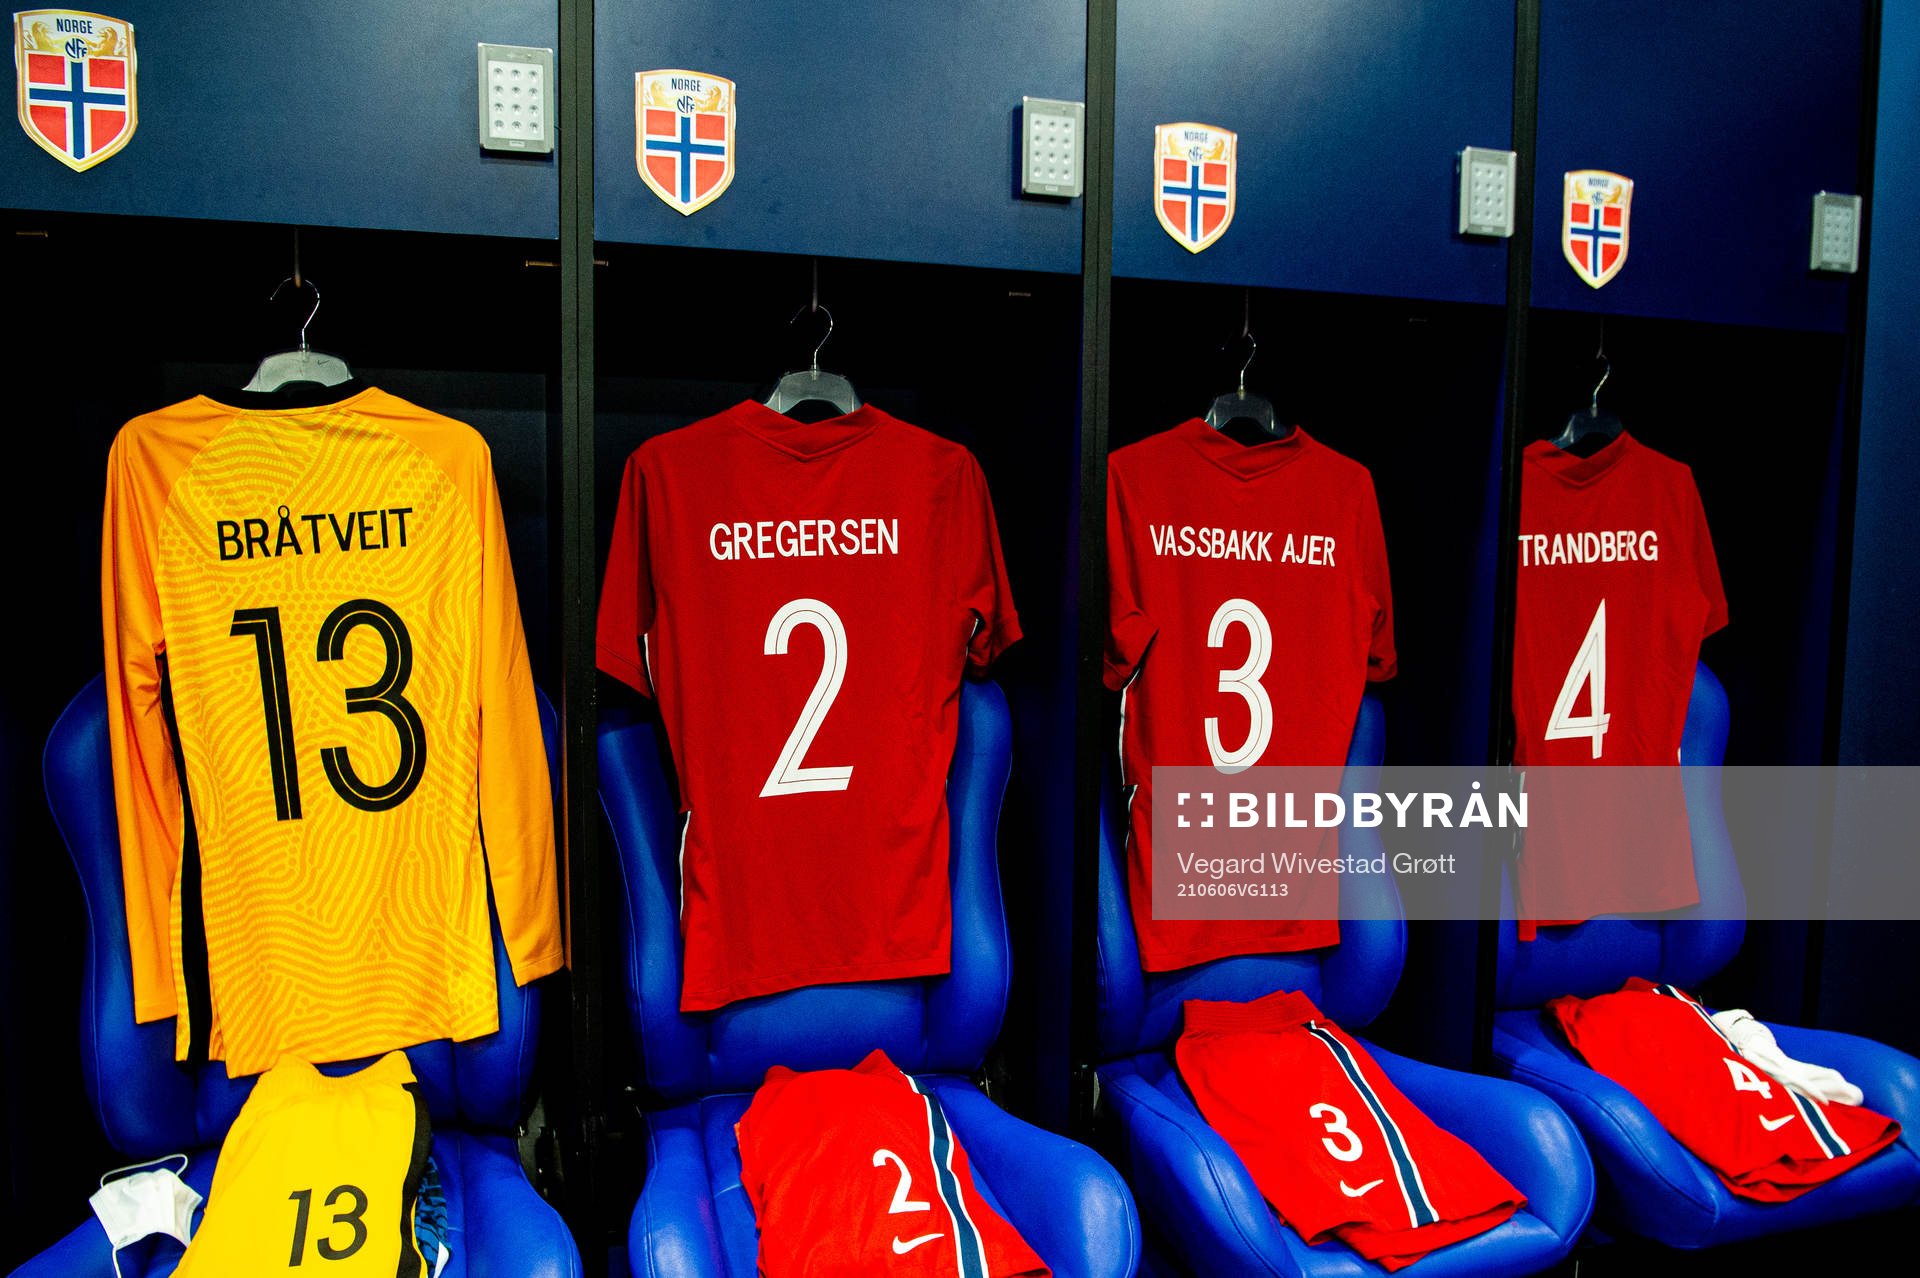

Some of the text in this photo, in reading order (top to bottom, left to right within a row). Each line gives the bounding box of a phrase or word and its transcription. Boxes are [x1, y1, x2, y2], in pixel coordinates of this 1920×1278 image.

[56, 18, 93, 34] NORGE
[671, 78, 701, 92] NORGE
[1184, 130, 1209, 143] NORGE
[217, 506, 413, 561] BRÅTVEIT
[710, 518, 899, 561] GREGERSEN
[1150, 524, 1336, 567] VASSBAKK AJER
[758, 598, 854, 798] 2
[1204, 598, 1274, 774] 3
[1544, 598, 1611, 760] 4
[229, 598, 427, 822] 13
[1722, 1057, 1773, 1099] 4
[1309, 1102, 1363, 1162] 3
[872, 1148, 931, 1214] 2
[288, 1184, 368, 1267] 13
